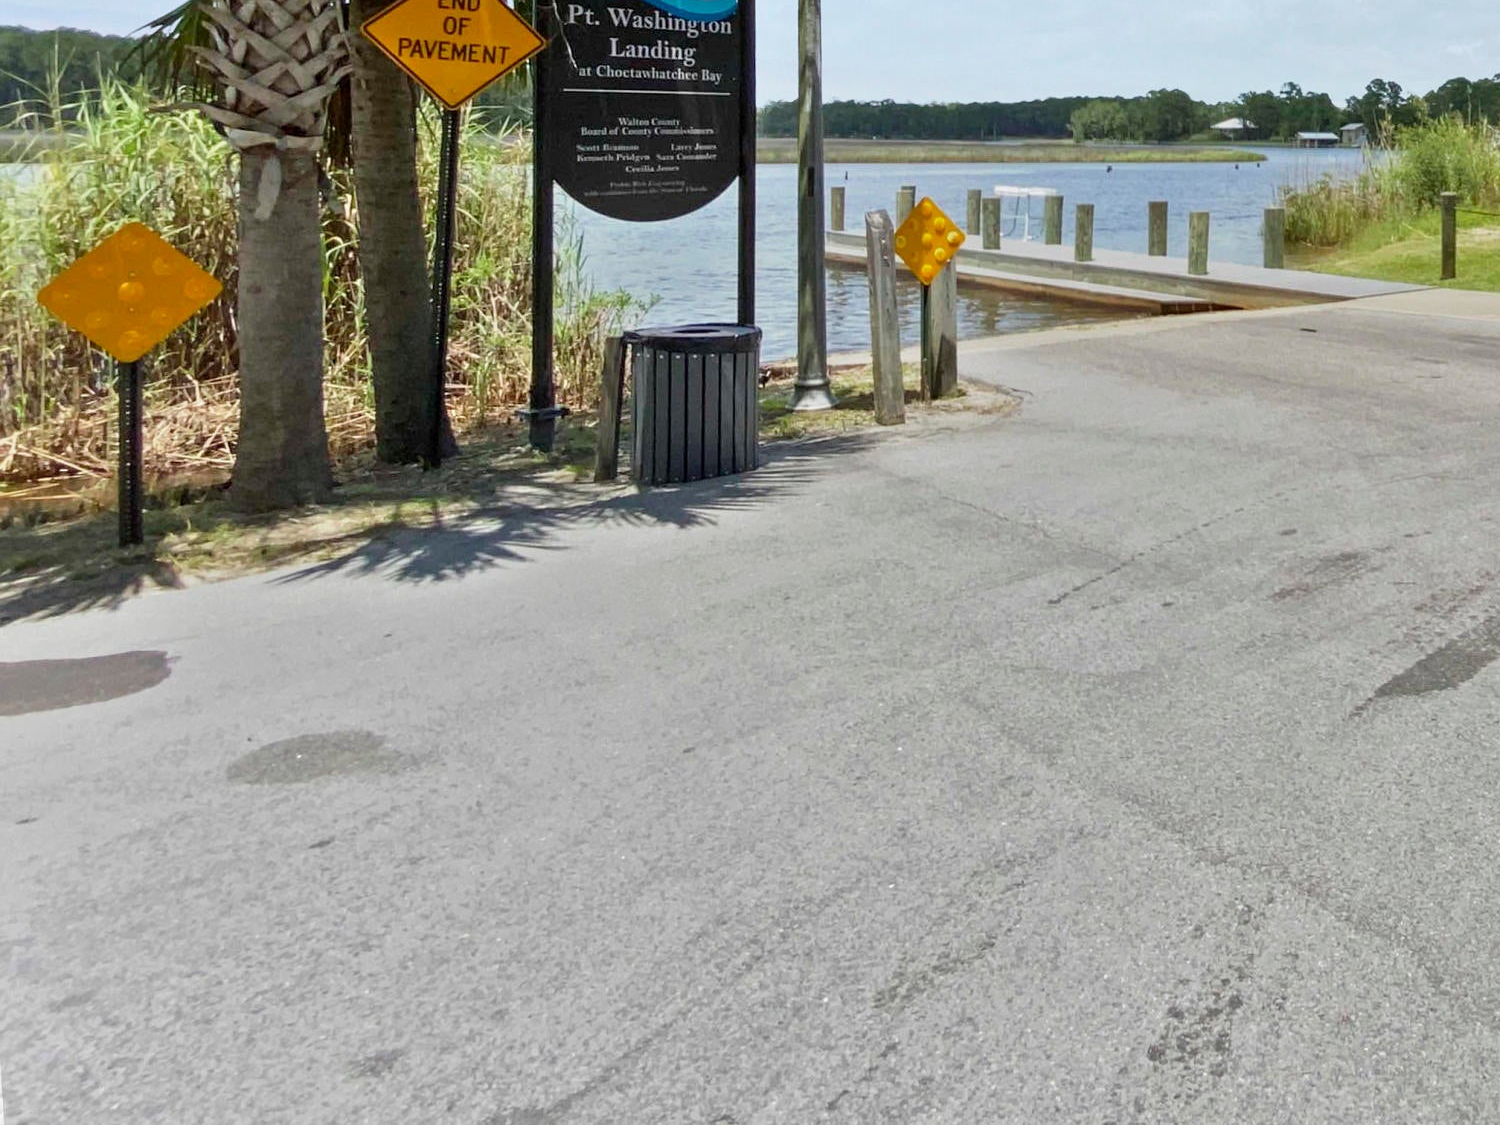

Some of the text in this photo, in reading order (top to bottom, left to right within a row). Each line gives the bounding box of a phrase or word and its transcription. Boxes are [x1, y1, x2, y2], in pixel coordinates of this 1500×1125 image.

[443, 16, 472, 35] OF
[568, 4, 732, 38] Pt. Washington
[398, 37, 511, 65] PAVEMENT
[609, 37, 696, 66] Landing
[579, 65, 722, 85] at Choctawhatchee Bay
[581, 127, 607, 136] Board
[609, 127, 620, 136] of
[622, 127, 651, 138] County
[618, 117, 680, 129] Walton County
